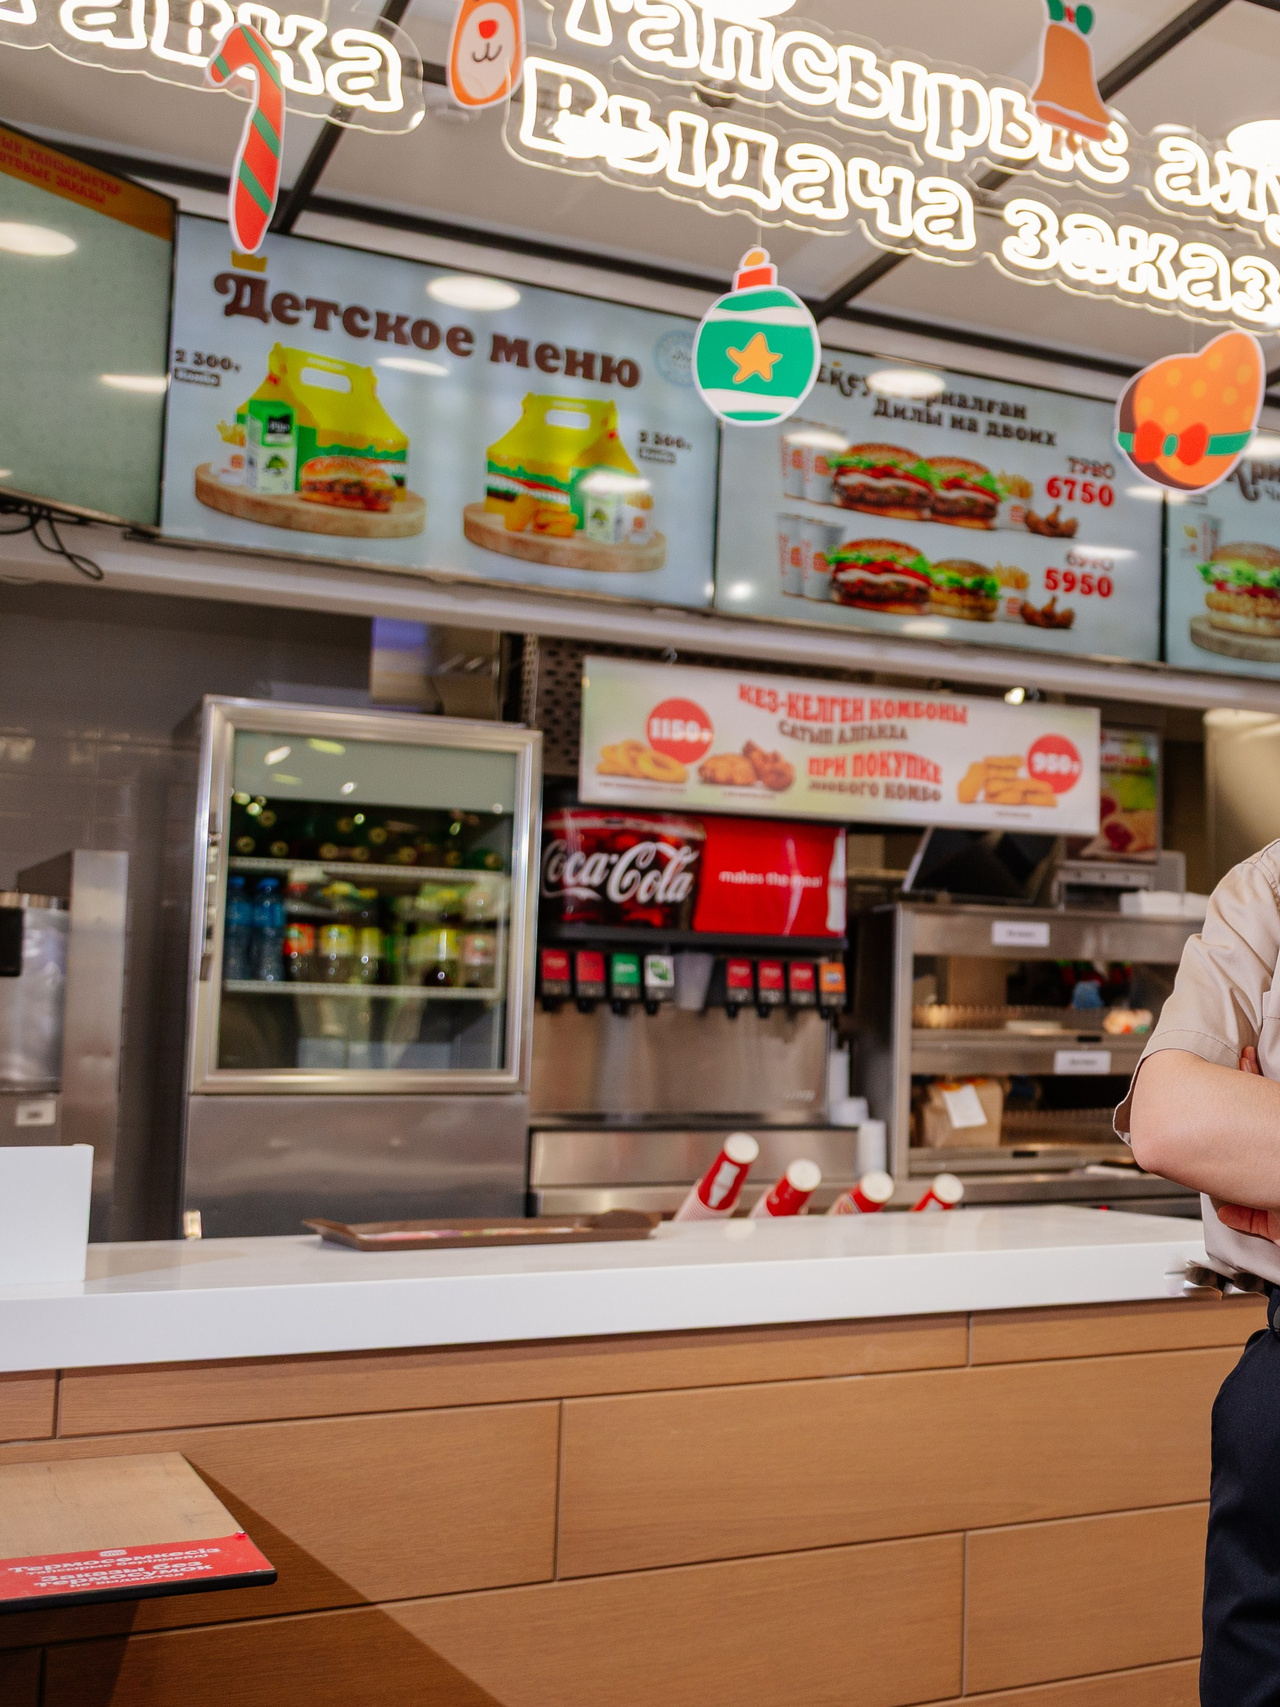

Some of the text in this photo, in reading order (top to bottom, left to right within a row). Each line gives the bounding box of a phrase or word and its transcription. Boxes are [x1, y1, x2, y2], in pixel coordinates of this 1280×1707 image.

[0, 0, 403, 113] авка
[519, 55, 977, 252] Выдача
[213, 271, 475, 358] Детское
[489, 332, 642, 389] меню
[908, 386, 1028, 420] рналған
[951, 414, 979, 434] на
[986, 420, 1058, 447] двоих
[1046, 476, 1116, 508] 6750
[1044, 568, 1114, 599] 5950
[869, 698, 969, 725] КОМБОНЫ
[778, 719, 834, 745] САТЫП
[808, 750, 943, 785] ПРИ ПОКУПКЕ
[718, 869, 765, 886] makes
[765, 870, 790, 888] the
[41, 1560, 203, 1582] Заказы без
